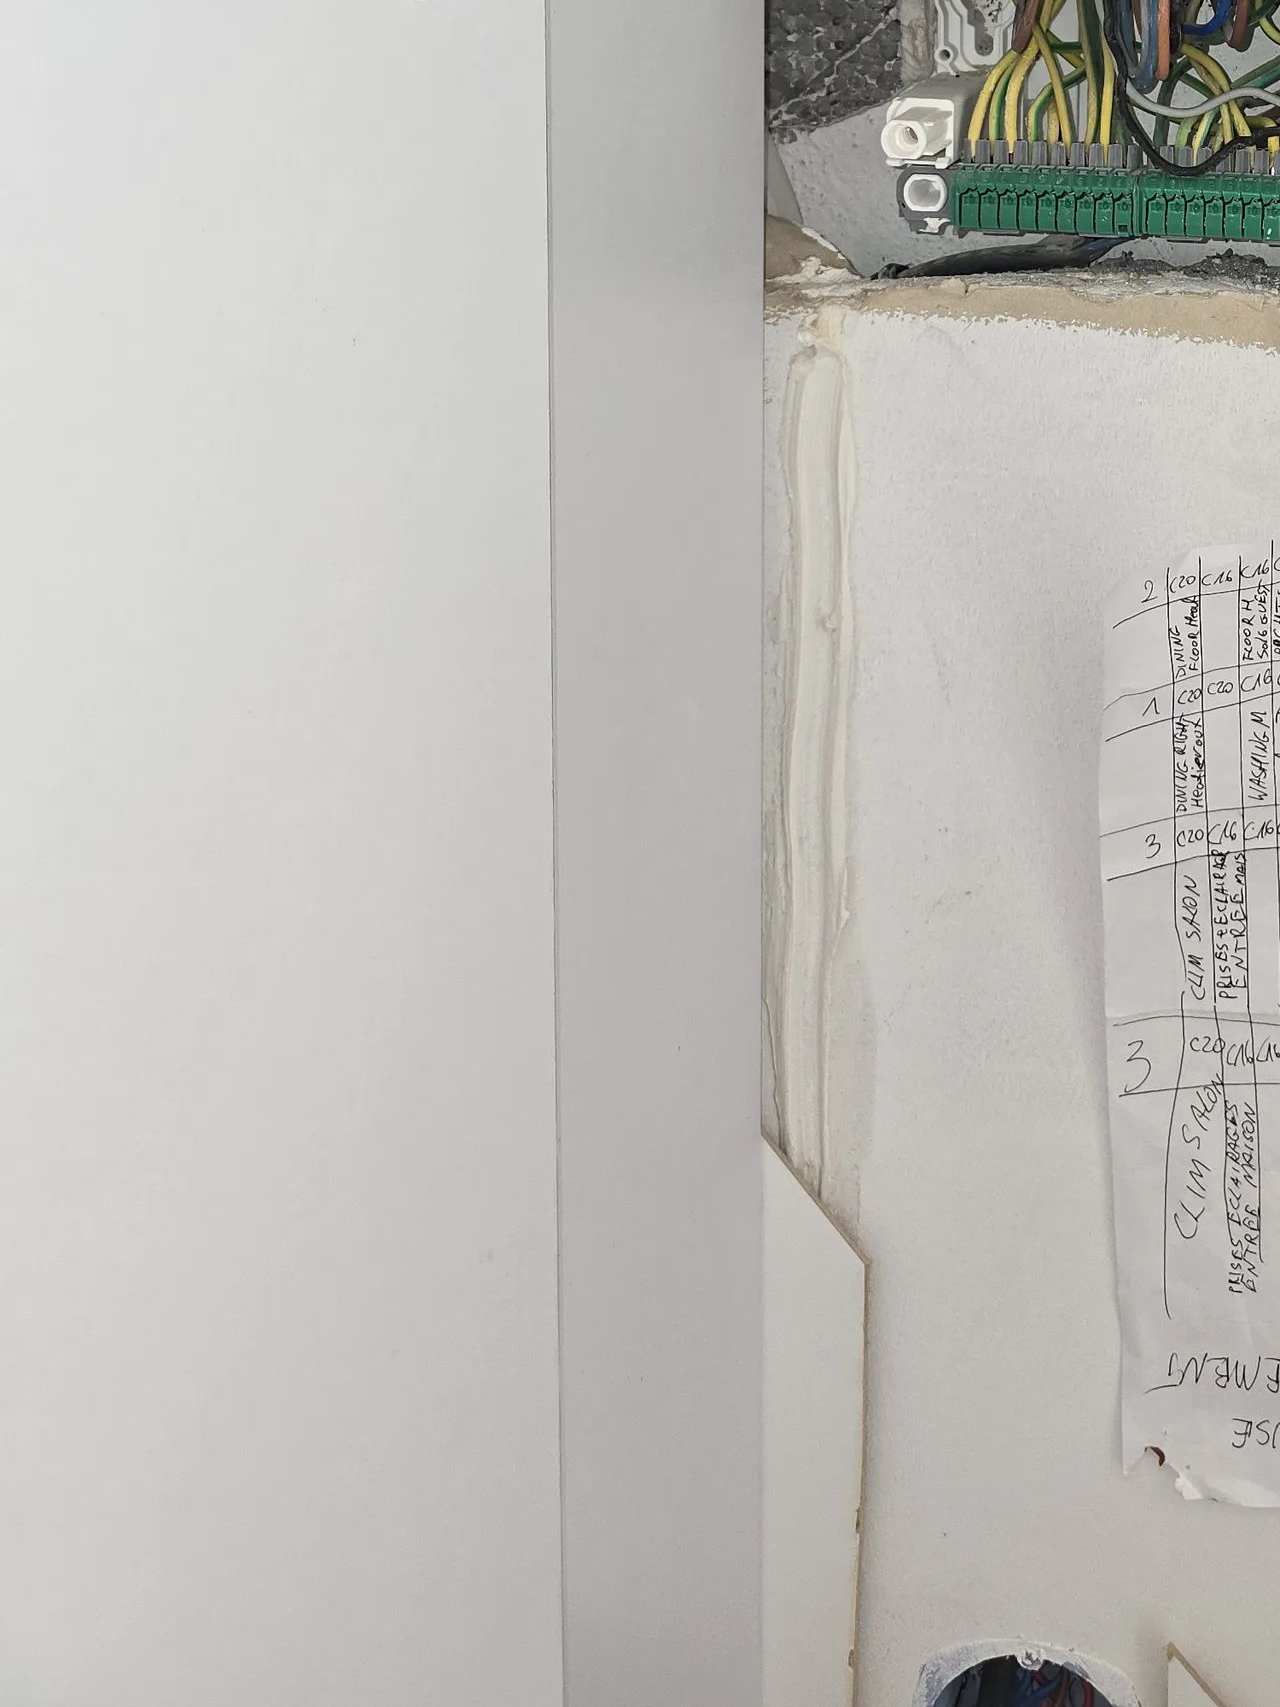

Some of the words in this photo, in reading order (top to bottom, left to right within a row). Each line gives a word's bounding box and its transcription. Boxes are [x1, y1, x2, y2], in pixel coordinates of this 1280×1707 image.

[1141, 580, 1158, 603] 2
[1169, 575, 1196, 594] C20
[1202, 570, 1232, 586] C16
[1169, 625, 1186, 679] DINING
[1187, 632, 1200, 671] FLOOR
[1207, 681, 1233, 695] C20
[1175, 756, 1188, 813] DINING
[1248, 731, 1269, 800] WASHING
[1145, 834, 1161, 859] 3
[1182, 875, 1201, 942] SALON
[1188, 954, 1205, 1000] CLIM
[1214, 944, 1237, 999] PRISES
[1123, 1040, 1152, 1094] 3
[1182, 1073, 1223, 1150] SALON
[1240, 1102, 1257, 1187] MAISON
[1174, 1159, 1210, 1239] CLIM
[1229, 1239, 1243, 1294] PRISES
